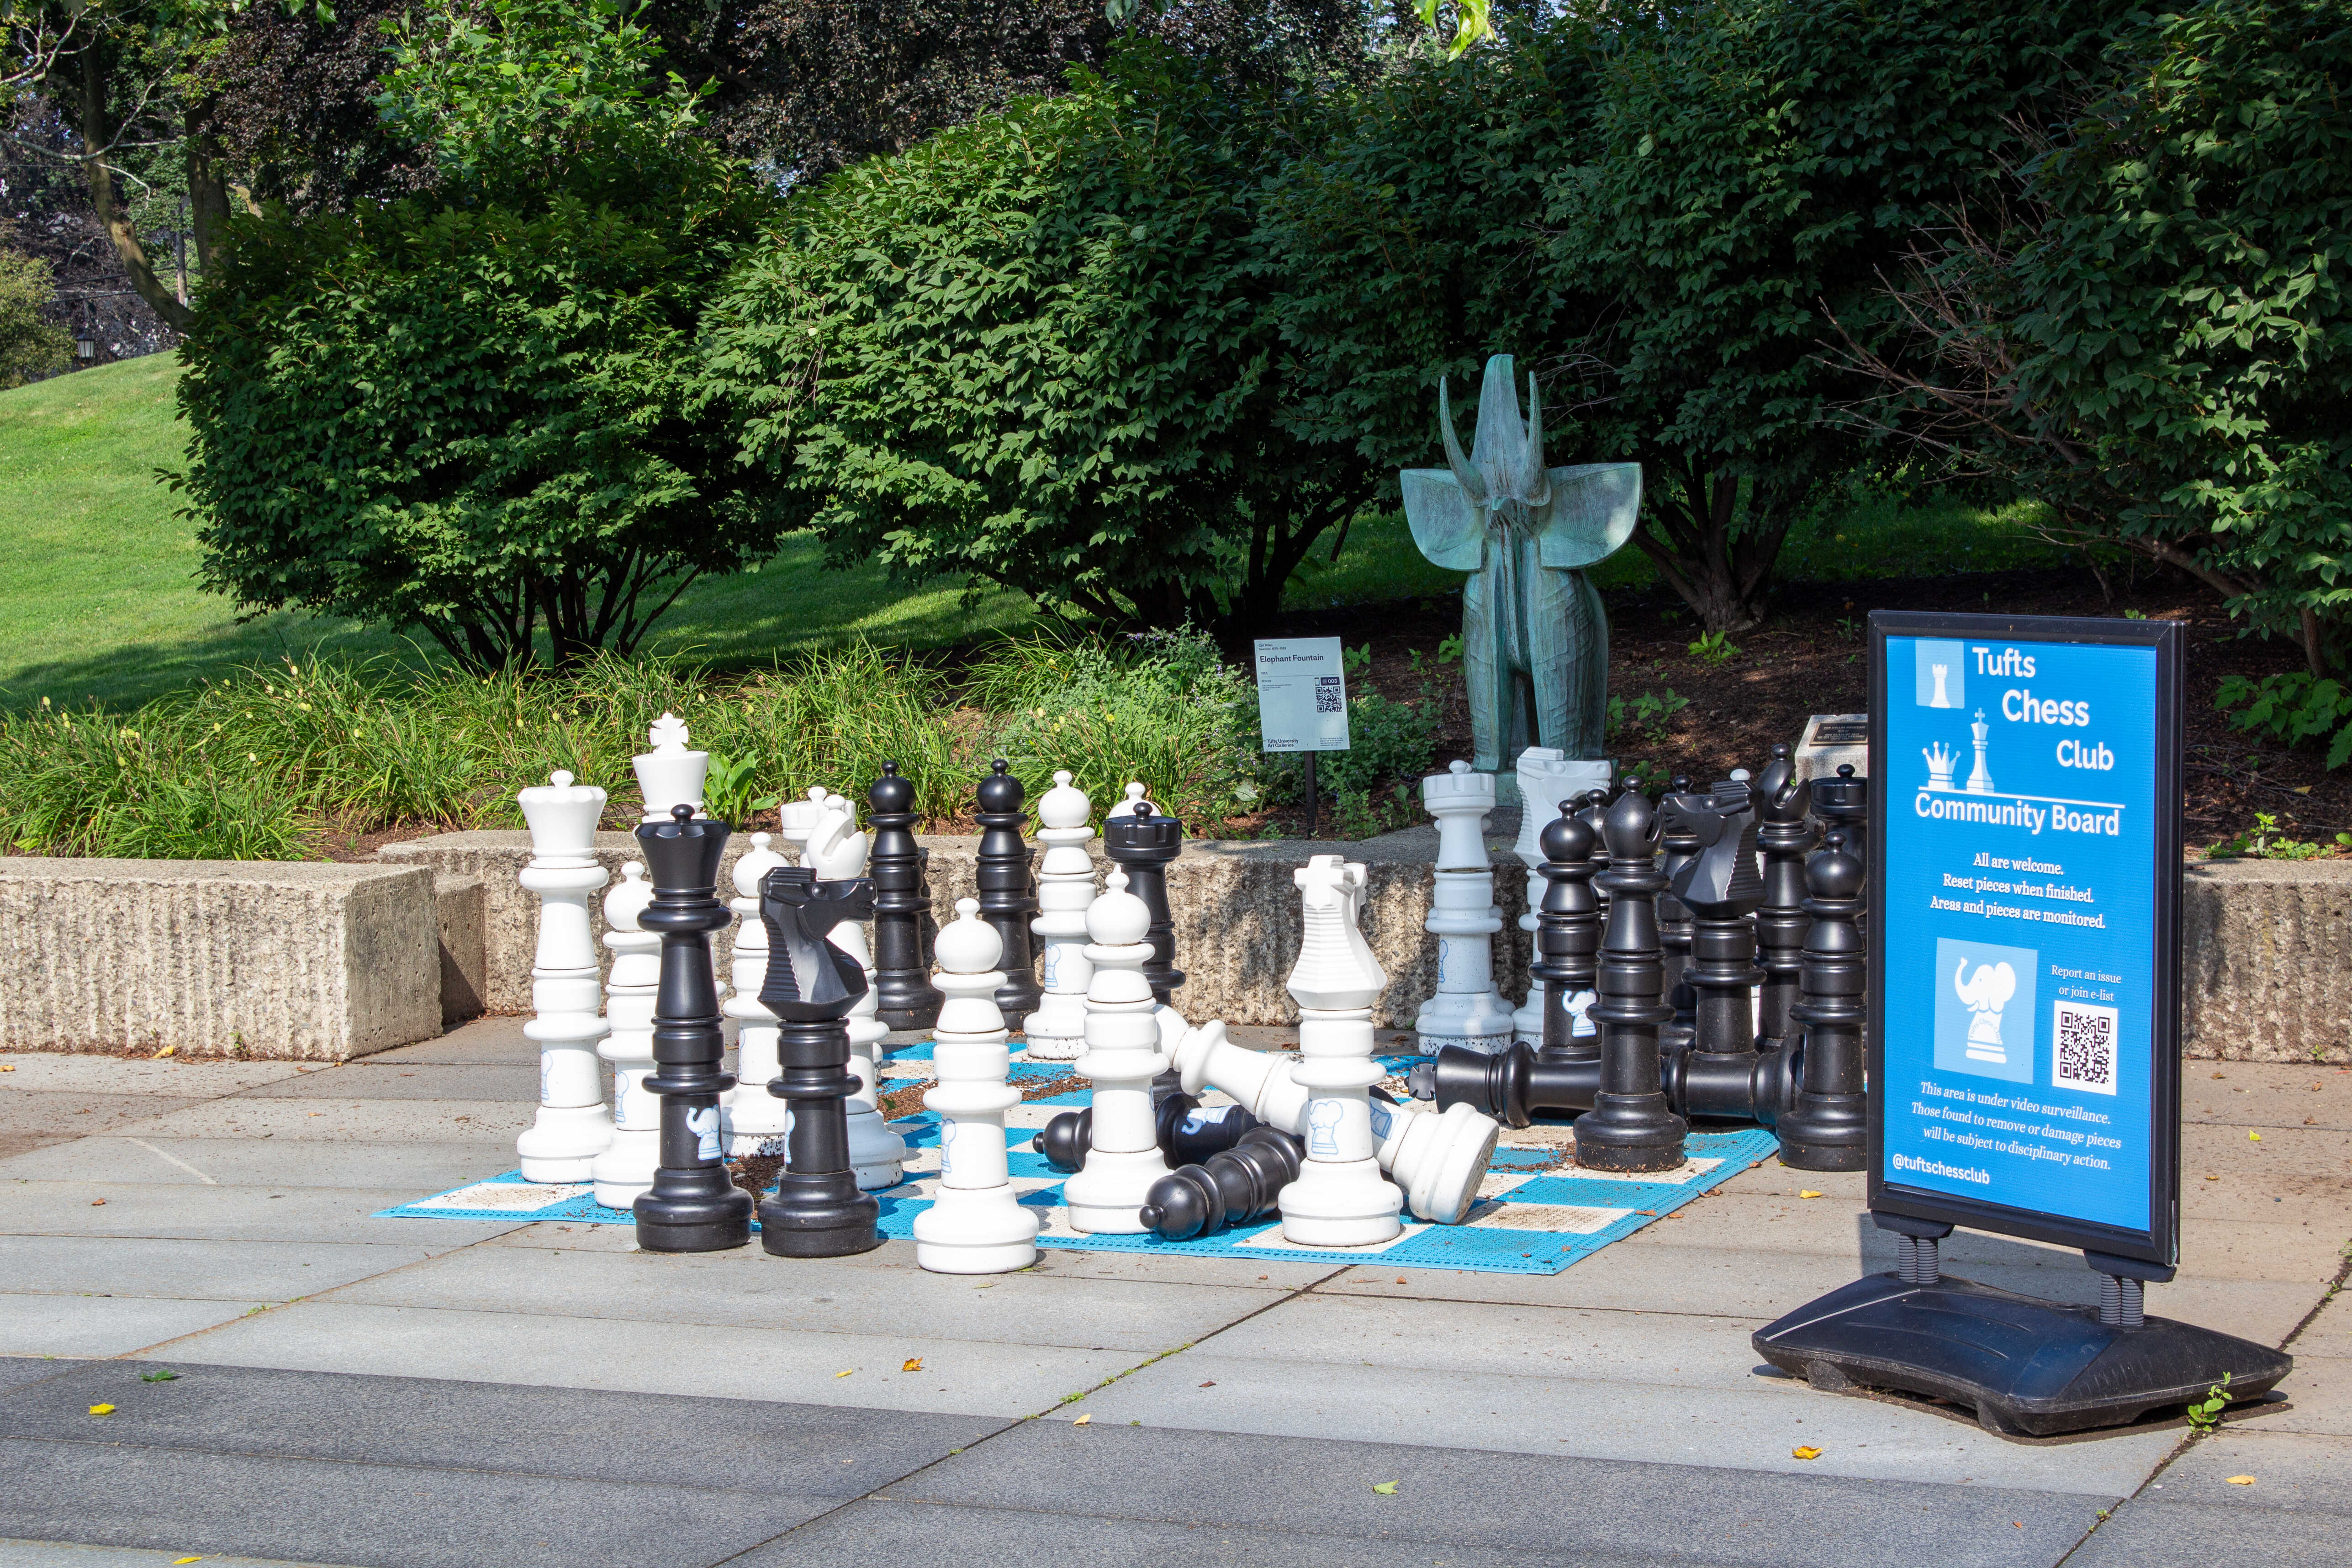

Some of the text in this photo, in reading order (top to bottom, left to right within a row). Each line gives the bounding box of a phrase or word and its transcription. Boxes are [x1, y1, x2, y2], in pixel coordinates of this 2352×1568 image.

[1260, 655, 1291, 664] Elephant
[1972, 647, 2035, 677] Tufts
[2003, 690, 2089, 726] Chess
[2057, 740, 2114, 770] Club
[1916, 793, 2119, 835] Community Board
[1973, 853, 2063, 875] All are welcome.
[1943, 873, 2093, 903] Reset pieces when finished.
[1930, 896, 2105, 928] Areas and pieces are monitored.
[2052, 965, 2082, 979] Report
[2098, 971, 2121, 983] issue
[2071, 986, 2088, 998] join
[2091, 989, 2114, 1001] e-list
[1921, 1082, 2110, 1124] This area is under video surveillance.
[1912, 1102, 2121, 1148] Those found to remove or damage pieces
[1924, 1127, 2110, 1169] will be subject to disciplinary action.
[1893, 1154, 1989, 1184] @tuftschessclub
